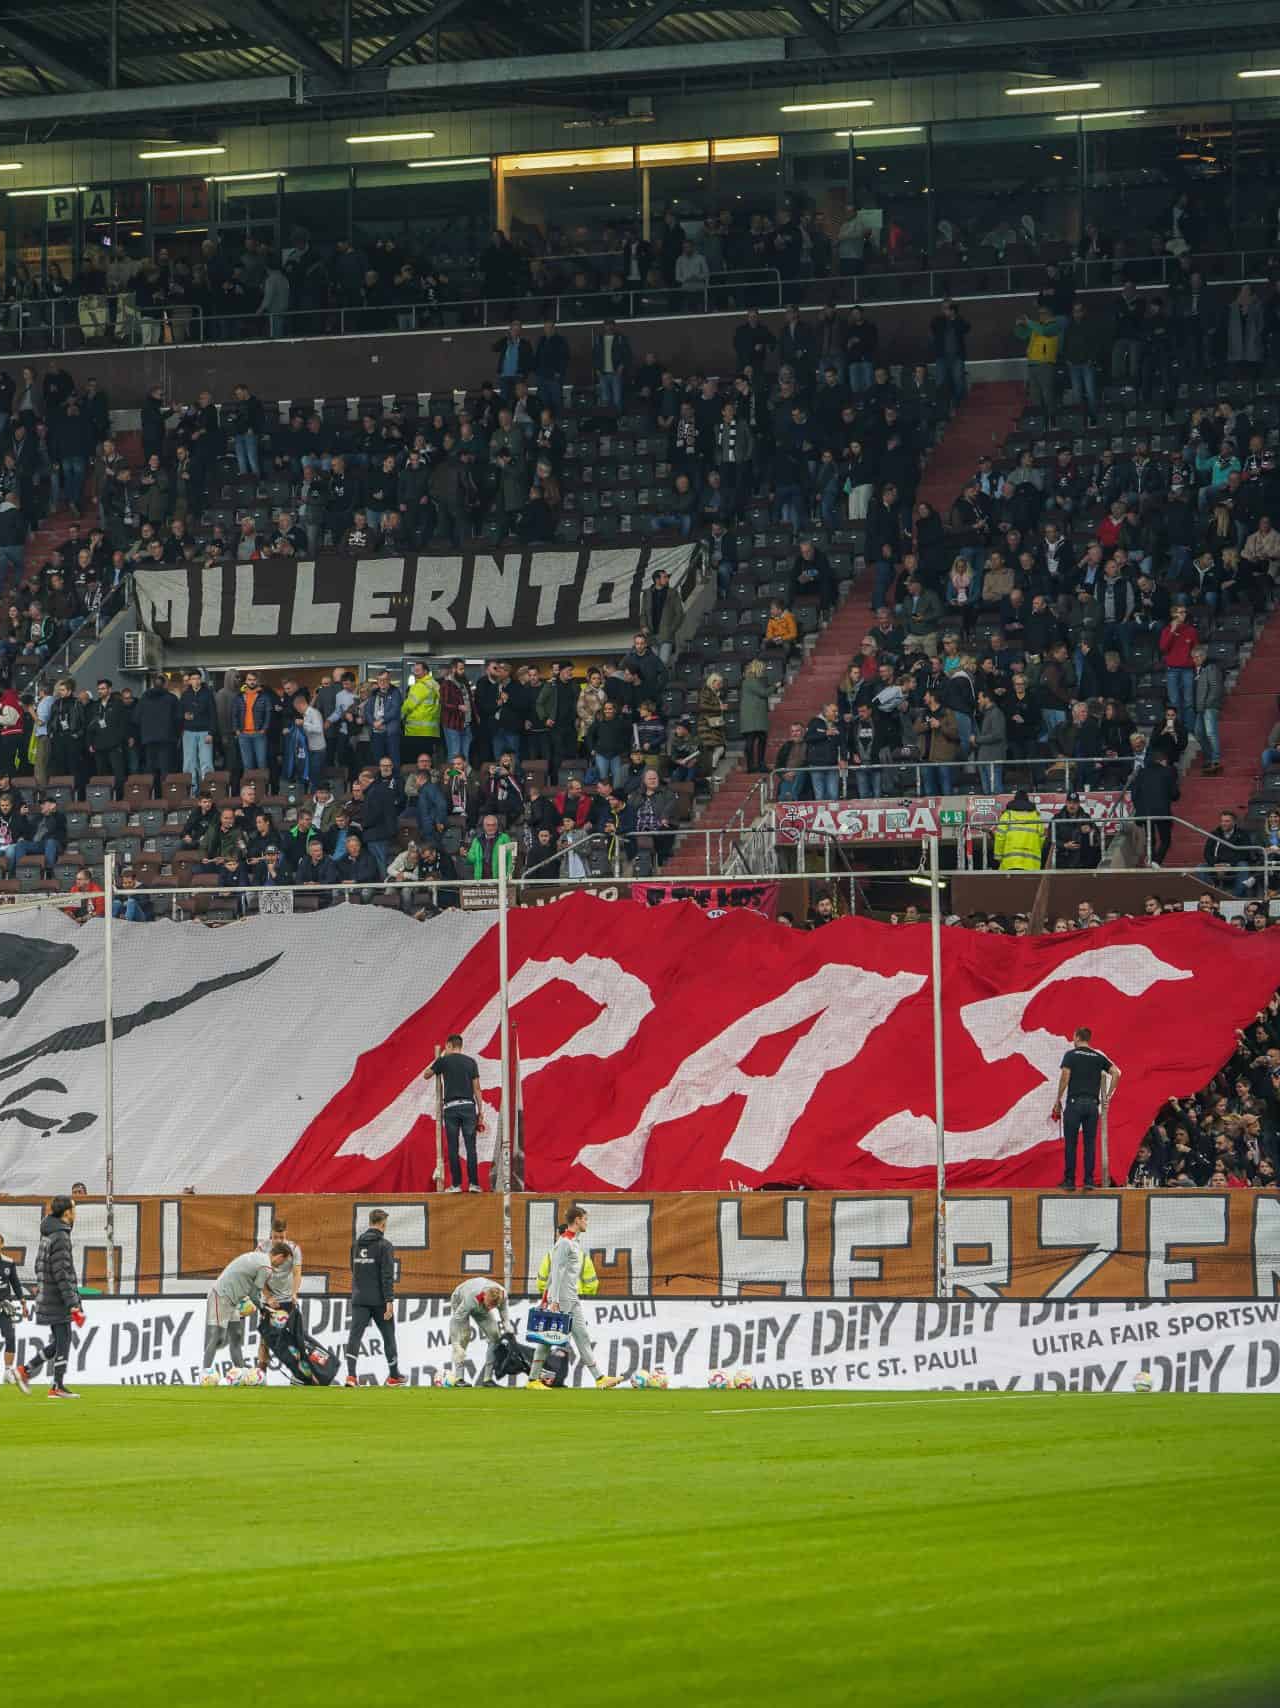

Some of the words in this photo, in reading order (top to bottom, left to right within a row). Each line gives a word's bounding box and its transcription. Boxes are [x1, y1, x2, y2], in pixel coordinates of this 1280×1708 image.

[812, 806, 938, 835] ASTRA
[596, 1300, 657, 1325] PAULI
[1032, 1329, 1104, 1356] ULTRA
[1111, 1321, 1161, 1345] FAIR
[1168, 1303, 1280, 1336] SPORTSW
[751, 1371, 804, 1390] ADE
[812, 1366, 838, 1386] BY
[846, 1362, 871, 1381] FC
[878, 1358, 907, 1378] ST.
[914, 1347, 978, 1373] PAULI
